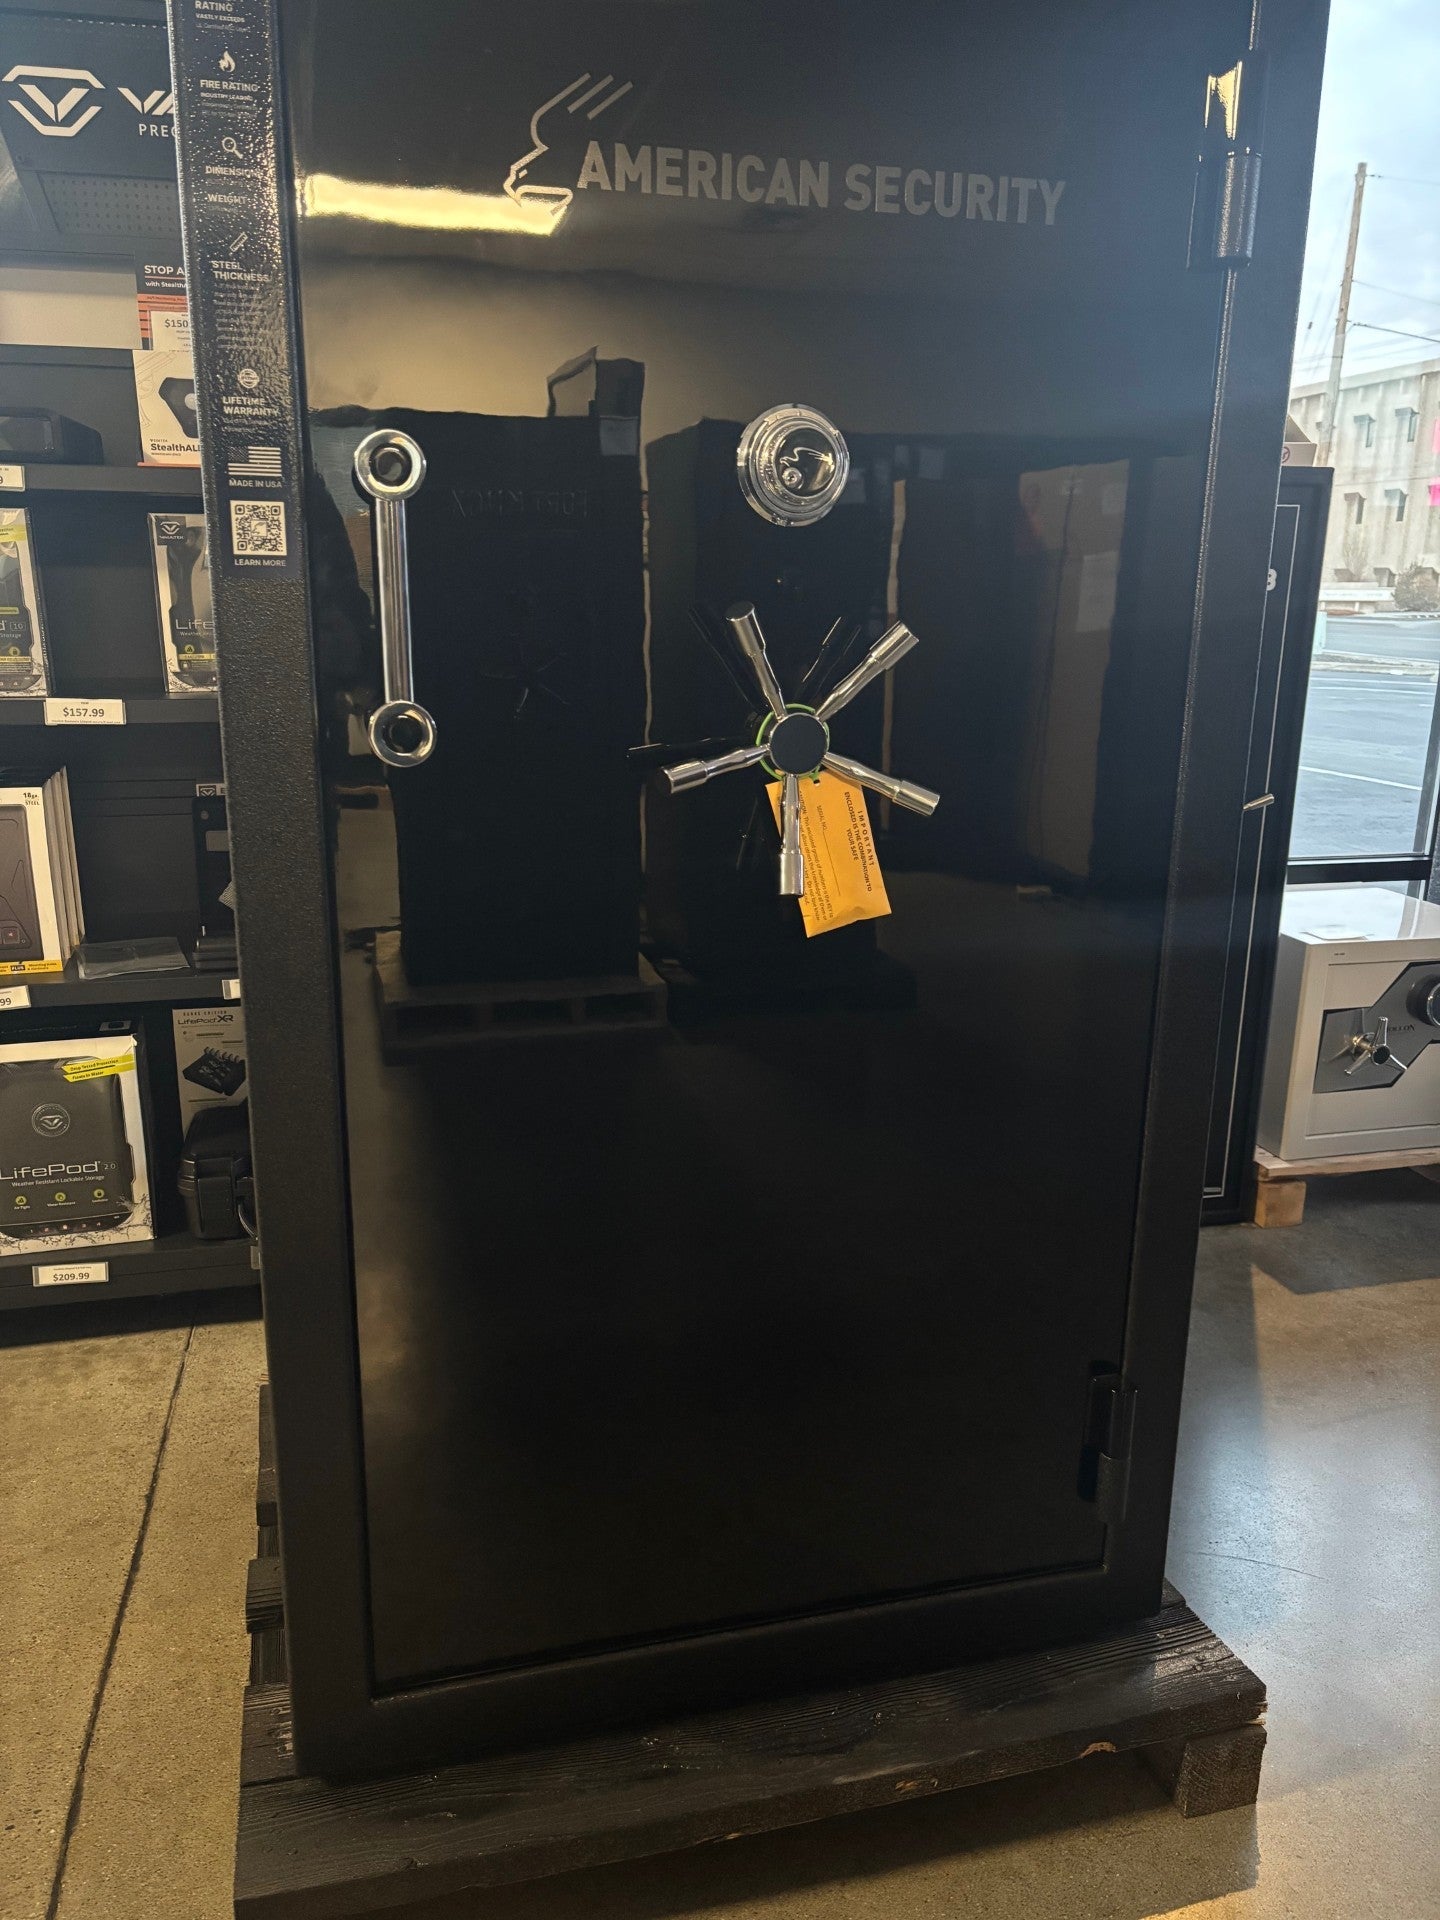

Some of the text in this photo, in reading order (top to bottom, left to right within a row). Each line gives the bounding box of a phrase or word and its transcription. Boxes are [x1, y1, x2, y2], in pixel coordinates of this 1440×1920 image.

[195, 1, 233, 12] RATING
[200, 80, 258, 92] FIRE RATING
[577, 141, 1066, 225] AMERICAN SECURITY
[207, 193, 247, 204] WEIGHT
[144, 265, 174, 275] STOP
[211, 260, 243, 270] STEEL
[213, 270, 270, 282] THICKNESS
[222, 396, 265, 406] LIFETIME
[223, 406, 280, 417] WARRANTY
[229, 479, 282, 488] MADE IN USA
[234, 559, 286, 567] LEARN MORE
[62, 707, 104, 717] $157.99
[844, 791, 856, 823] ENCLOSED
[858, 842, 871, 884] COMBINATION
[858, 810, 874, 866] IMPORTANT
[846, 828, 858, 861] YOUR SAFE
[0, 1161, 99, 1180] LifePod
[35, 1178, 60, 1186] Resistant
[53, 1272, 90, 1282] $209.99
